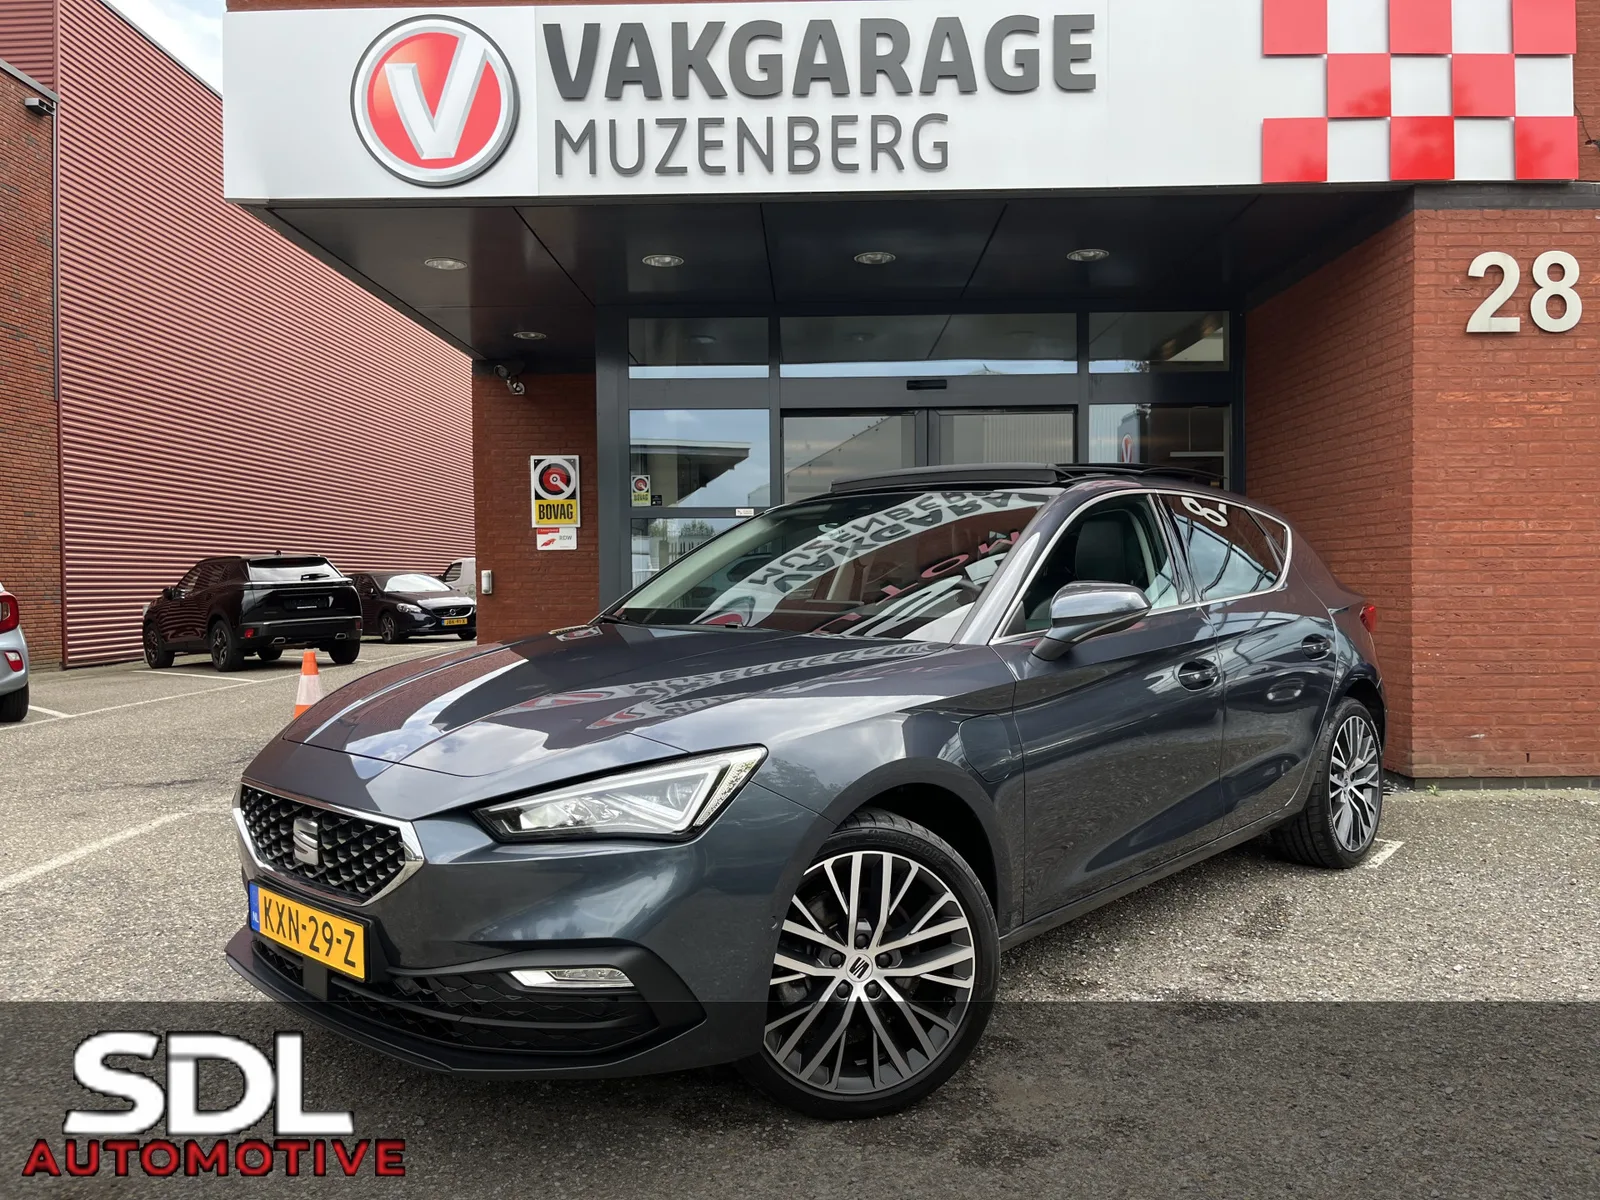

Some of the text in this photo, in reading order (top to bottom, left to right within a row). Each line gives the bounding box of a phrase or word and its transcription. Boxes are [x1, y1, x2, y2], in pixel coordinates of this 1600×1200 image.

[542, 14, 1097, 100] VAKGARAGE
[554, 113, 949, 176] MUZENBERG
[1466, 250, 1583, 333] 28
[538, 503, 574, 520] BOVAG
[252, 910, 260, 924] NL
[263, 896, 356, 968] KXN-29-Z
